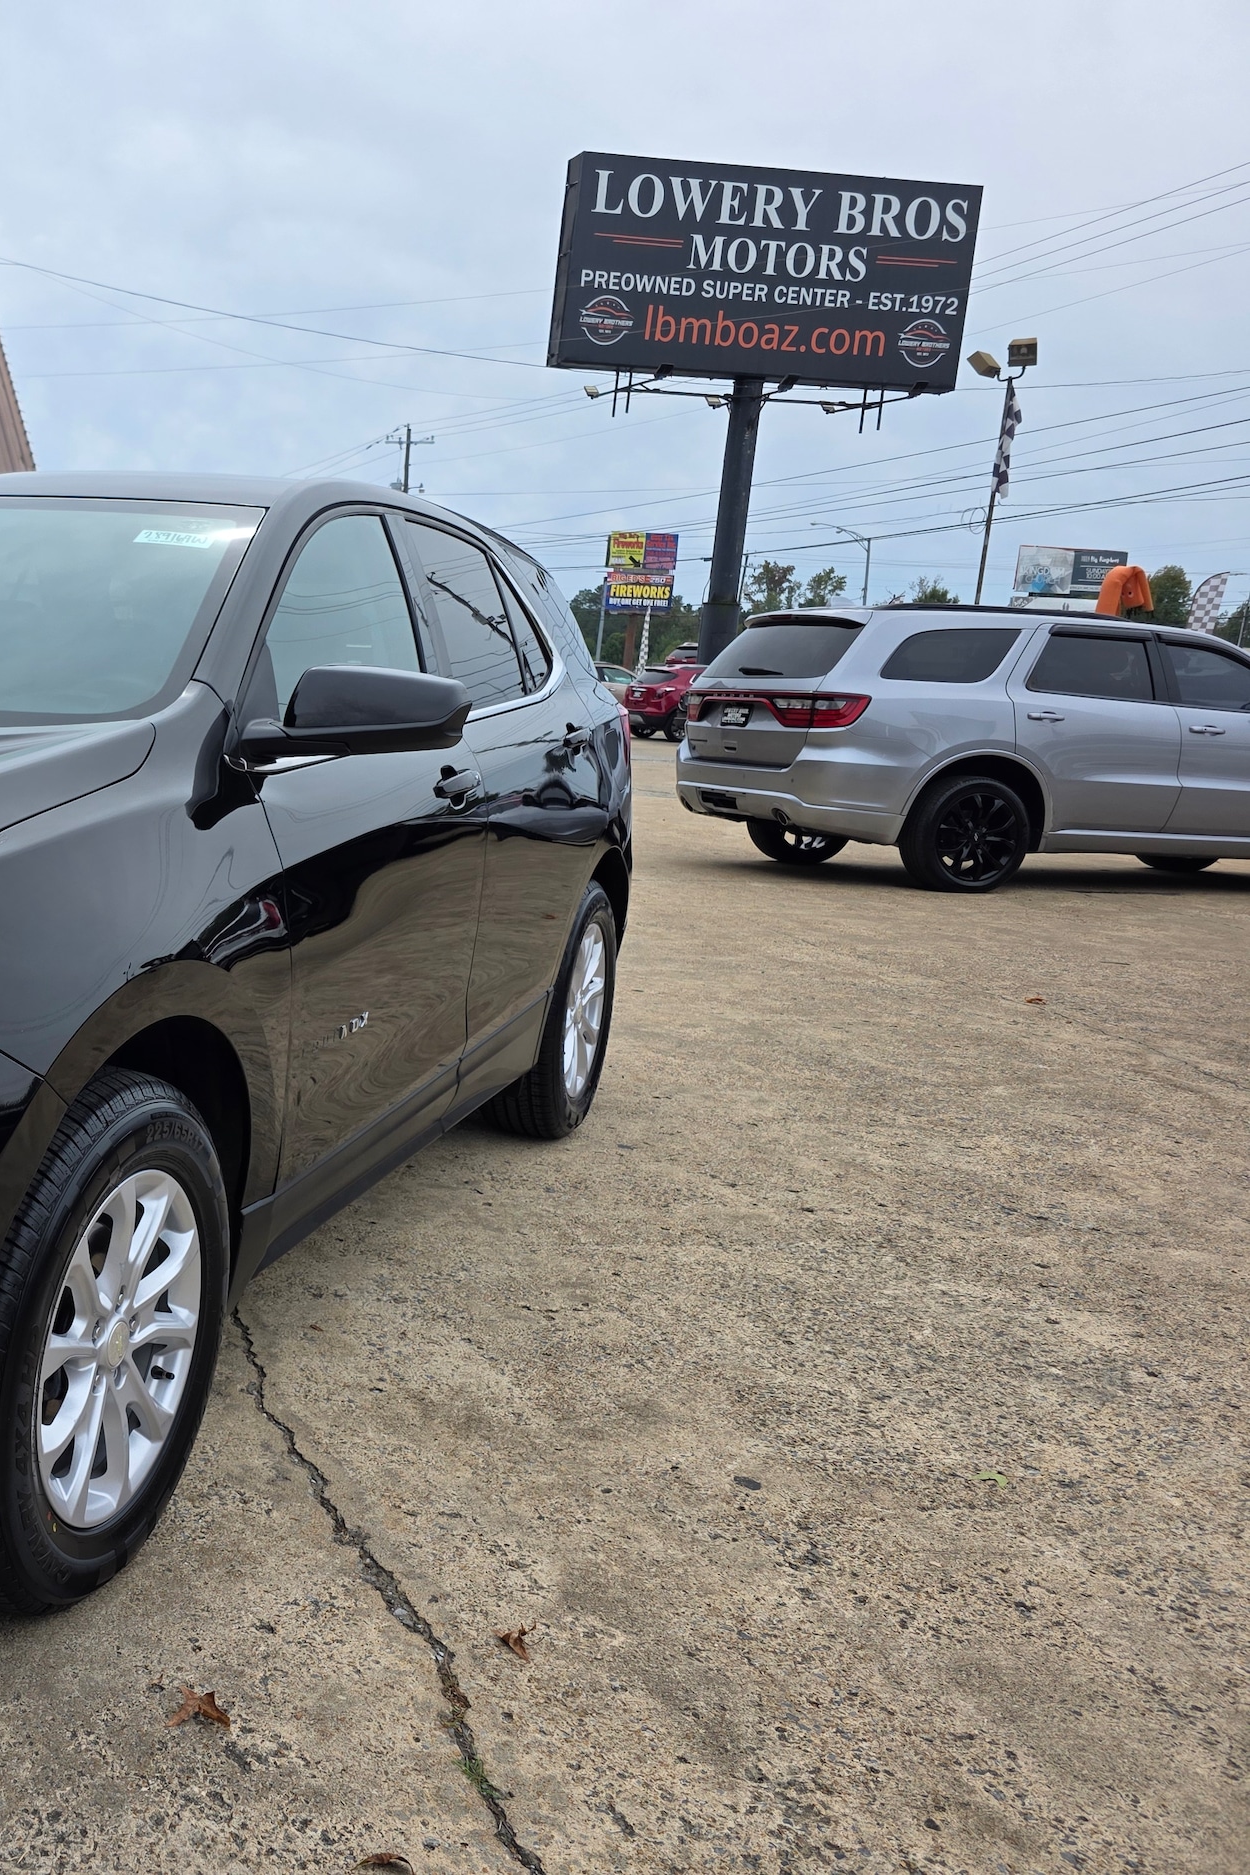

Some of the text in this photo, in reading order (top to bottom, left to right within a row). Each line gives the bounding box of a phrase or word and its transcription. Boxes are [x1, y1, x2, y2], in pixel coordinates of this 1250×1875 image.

[591, 169, 969, 243] LOWERY BROS
[687, 233, 868, 283] MOTORS
[580, 269, 696, 298] PREOWNED
[701, 280, 769, 303] SUPER
[773, 285, 849, 309] CENTER
[867, 292, 959, 316] EST.1972
[579, 316, 634, 326] LOWERY BROTHERS
[643, 304, 886, 357] lbmboaz.com
[898, 339, 951, 349] LOWERY BROTHERS
[610, 584, 670, 599] FIREWORKS
[611, 573, 627, 582] BIG
[1025, 574, 1061, 584] CHURCH
[632, 598, 643, 606] GET
[146, 1120, 205, 1152] 225/65R17
[15, 1401, 29, 1477] 4X4
[17, 1489, 73, 1585] CAVALRY
